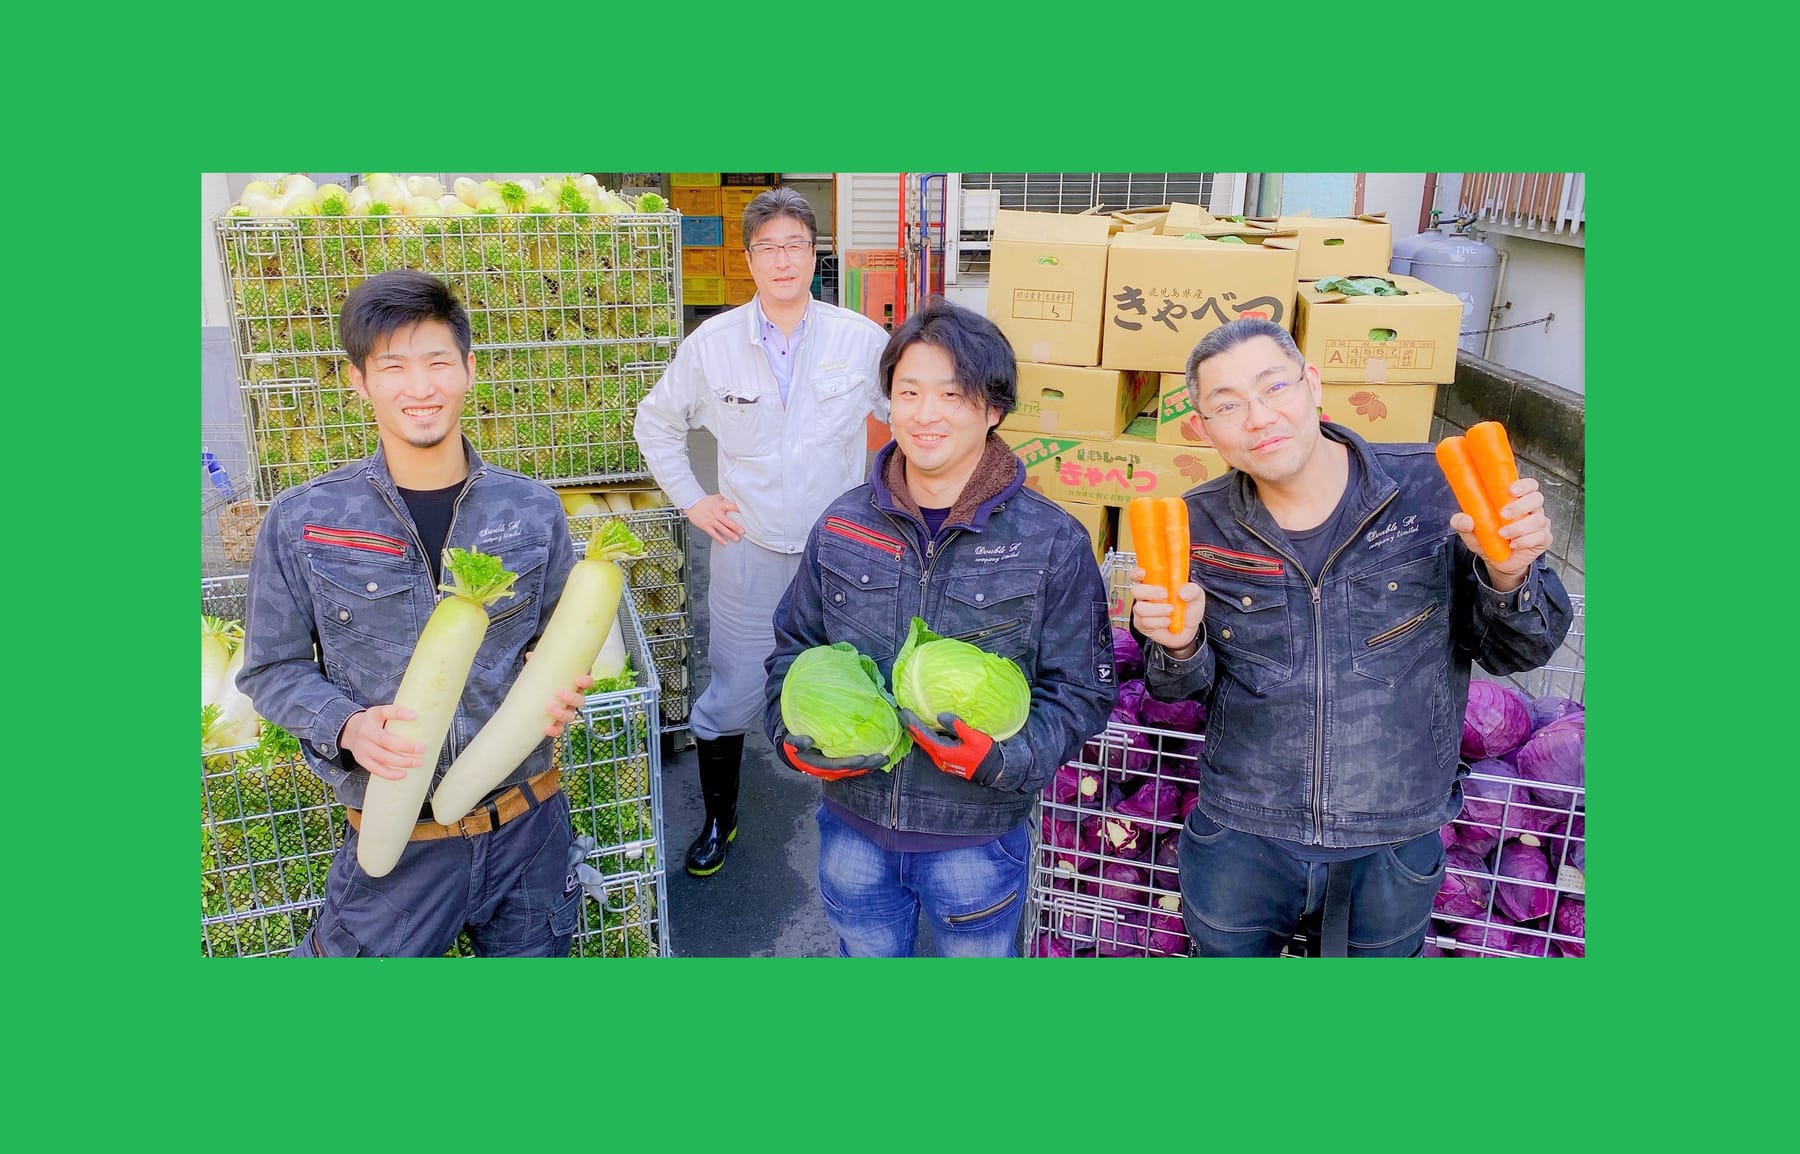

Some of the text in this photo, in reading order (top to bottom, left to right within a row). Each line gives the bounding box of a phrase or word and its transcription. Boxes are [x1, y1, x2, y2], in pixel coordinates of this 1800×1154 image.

[1149, 287, 1203, 299] 鹿児島県産
[1112, 285, 1284, 333] きゃべつ
[1328, 350, 1344, 364] A
[1363, 348, 1371, 356] 5
[1376, 348, 1385, 356] 6
[1349, 358, 1359, 366] 8
[478, 523, 506, 538] Double
[1366, 514, 1417, 542] Double H
[974, 545, 1006, 555] Double
